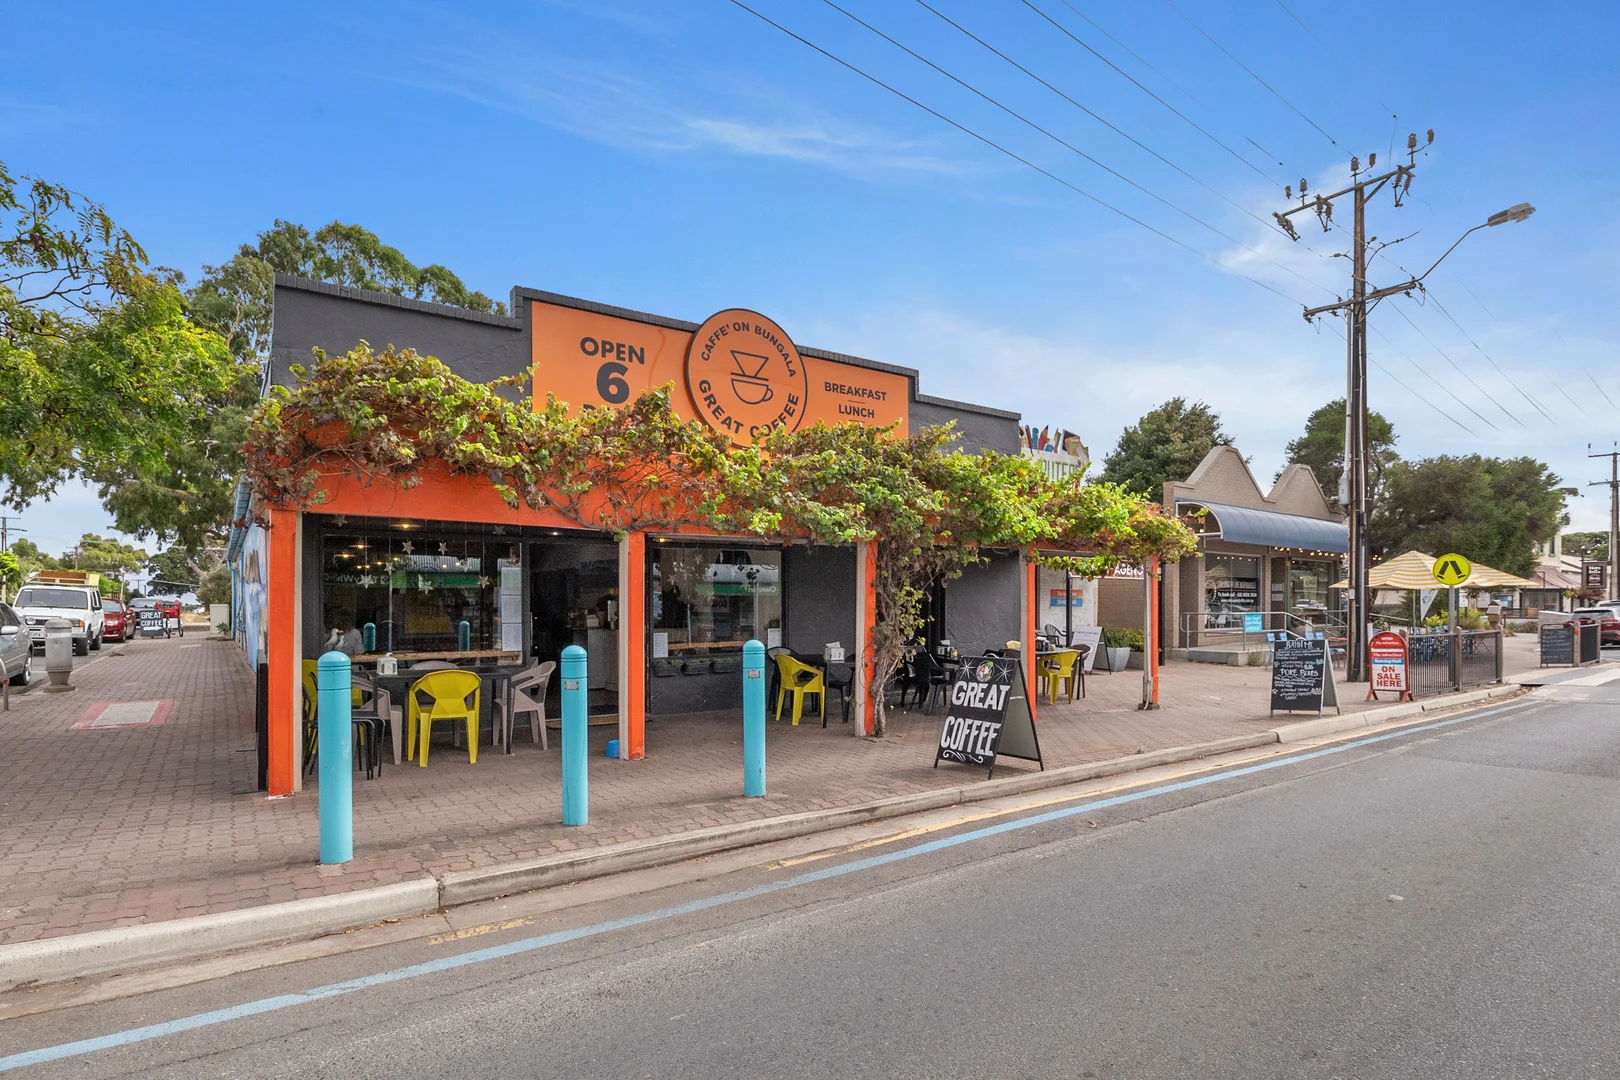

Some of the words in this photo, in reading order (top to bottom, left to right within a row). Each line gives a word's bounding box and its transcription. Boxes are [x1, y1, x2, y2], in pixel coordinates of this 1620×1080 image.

[580, 336, 645, 365] OPEN
[701, 323, 730, 361] CAFFE'
[733, 322, 750, 332] ON
[754, 325, 796, 378] BUNGALA
[596, 361, 630, 404] 6
[824, 381, 887, 401] BREAKFAST
[699, 379, 744, 434] GREAT
[749, 393, 799, 438] COFFEE
[838, 403, 875, 419] LUNCH
[140, 619, 162, 627] COFFEE
[141, 611, 162, 619] GREAT
[1377, 672, 1401, 680] SALE
[1381, 665, 1395, 673] ON
[951, 680, 1011, 711] GREAT
[940, 715, 1002, 757] COFFEE
